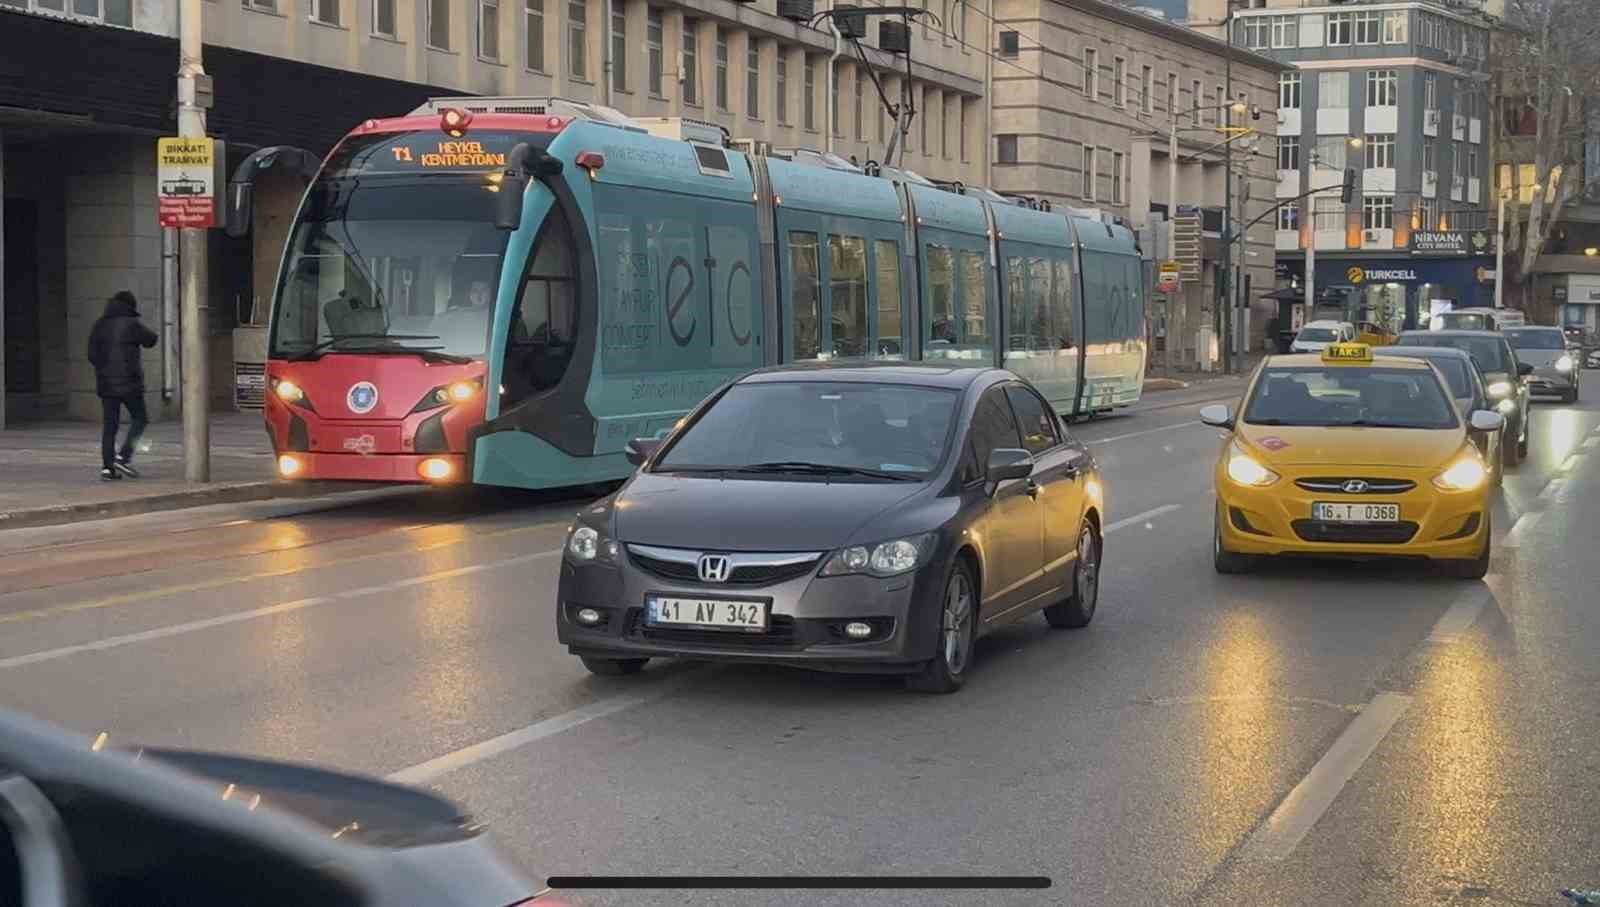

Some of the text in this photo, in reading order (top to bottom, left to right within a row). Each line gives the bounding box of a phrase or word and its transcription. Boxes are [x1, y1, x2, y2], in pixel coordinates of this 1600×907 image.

[392, 147, 413, 161] T1
[438, 142, 484, 154] HEYKEL
[163, 156, 209, 164] TRAMVAY
[1364, 269, 1417, 280] TURKCELL
[1321, 505, 1396, 520] 16 T 0368
[661, 600, 759, 625] 41 AV 342
